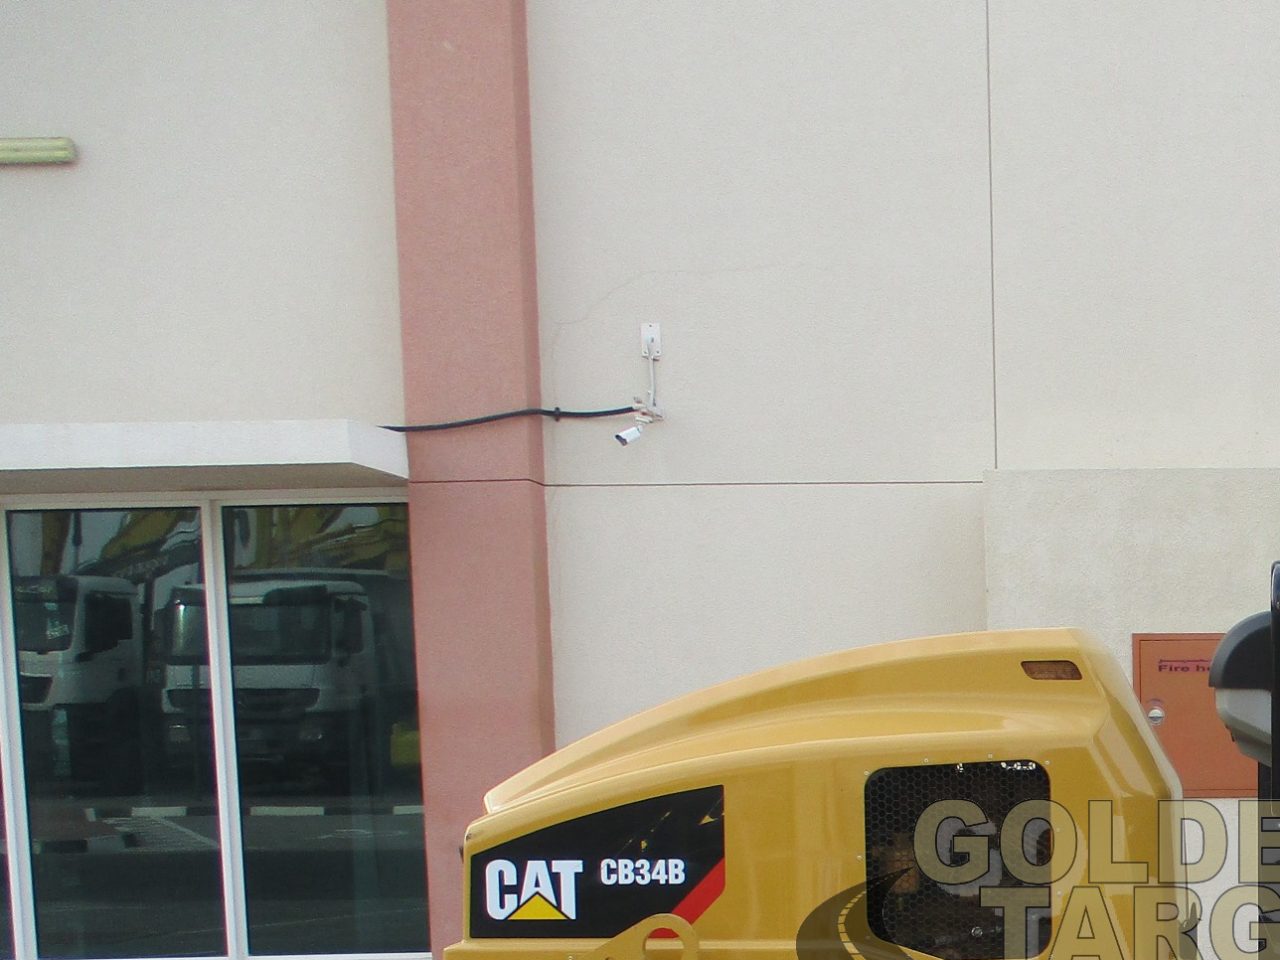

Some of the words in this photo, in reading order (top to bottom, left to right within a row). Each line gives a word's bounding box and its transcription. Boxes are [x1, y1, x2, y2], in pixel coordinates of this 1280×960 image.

[1158, 664, 1190, 672] Fire
[486, 859, 583, 920] CAT
[600, 858, 685, 885] CB34B
